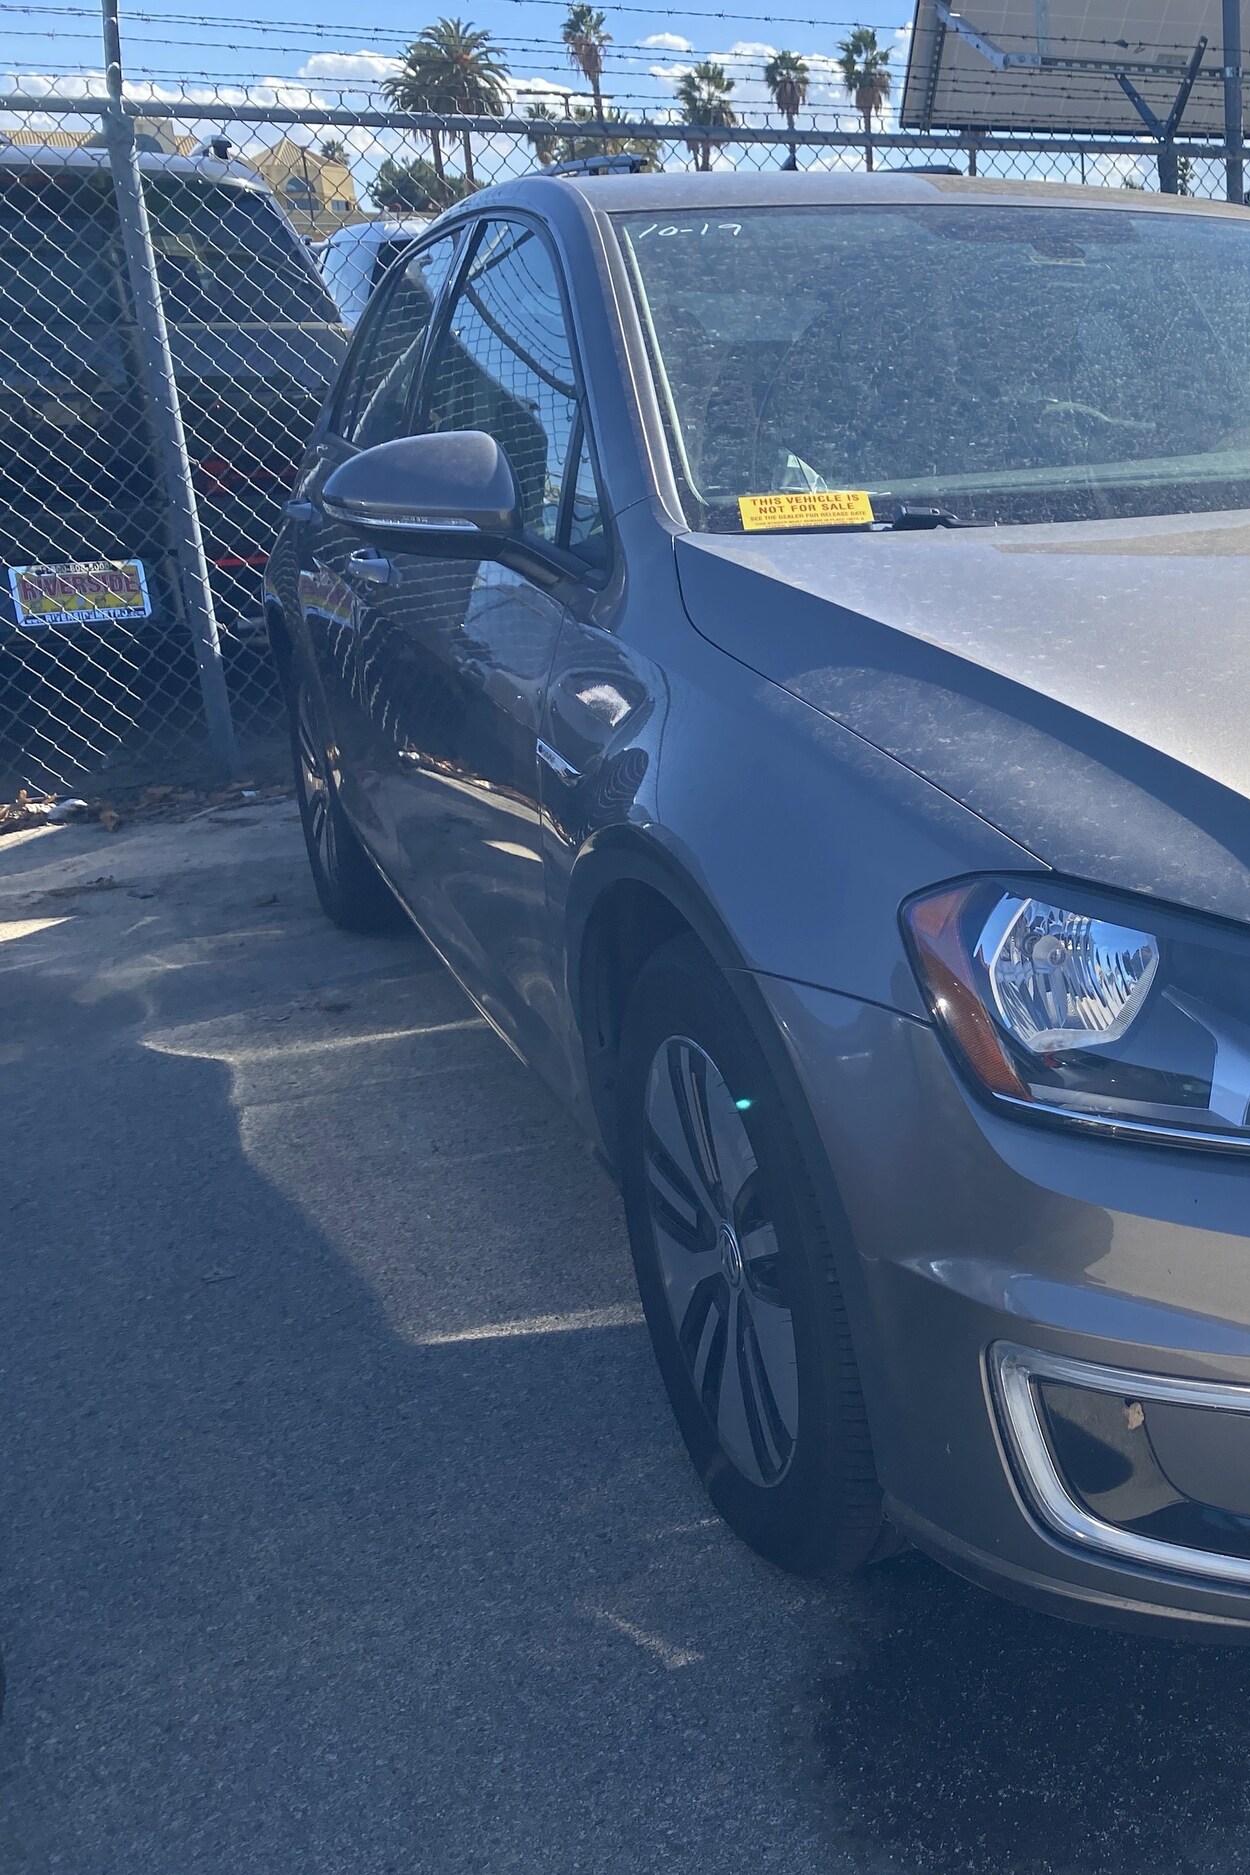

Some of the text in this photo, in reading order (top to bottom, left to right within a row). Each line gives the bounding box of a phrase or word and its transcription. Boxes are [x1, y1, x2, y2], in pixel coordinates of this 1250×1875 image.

[751, 497, 782, 506] THIS
[786, 494, 841, 504] VEHICLE
[758, 502, 855, 514] NOT FOR SALE
[20, 572, 138, 600] RIVERSIDE
